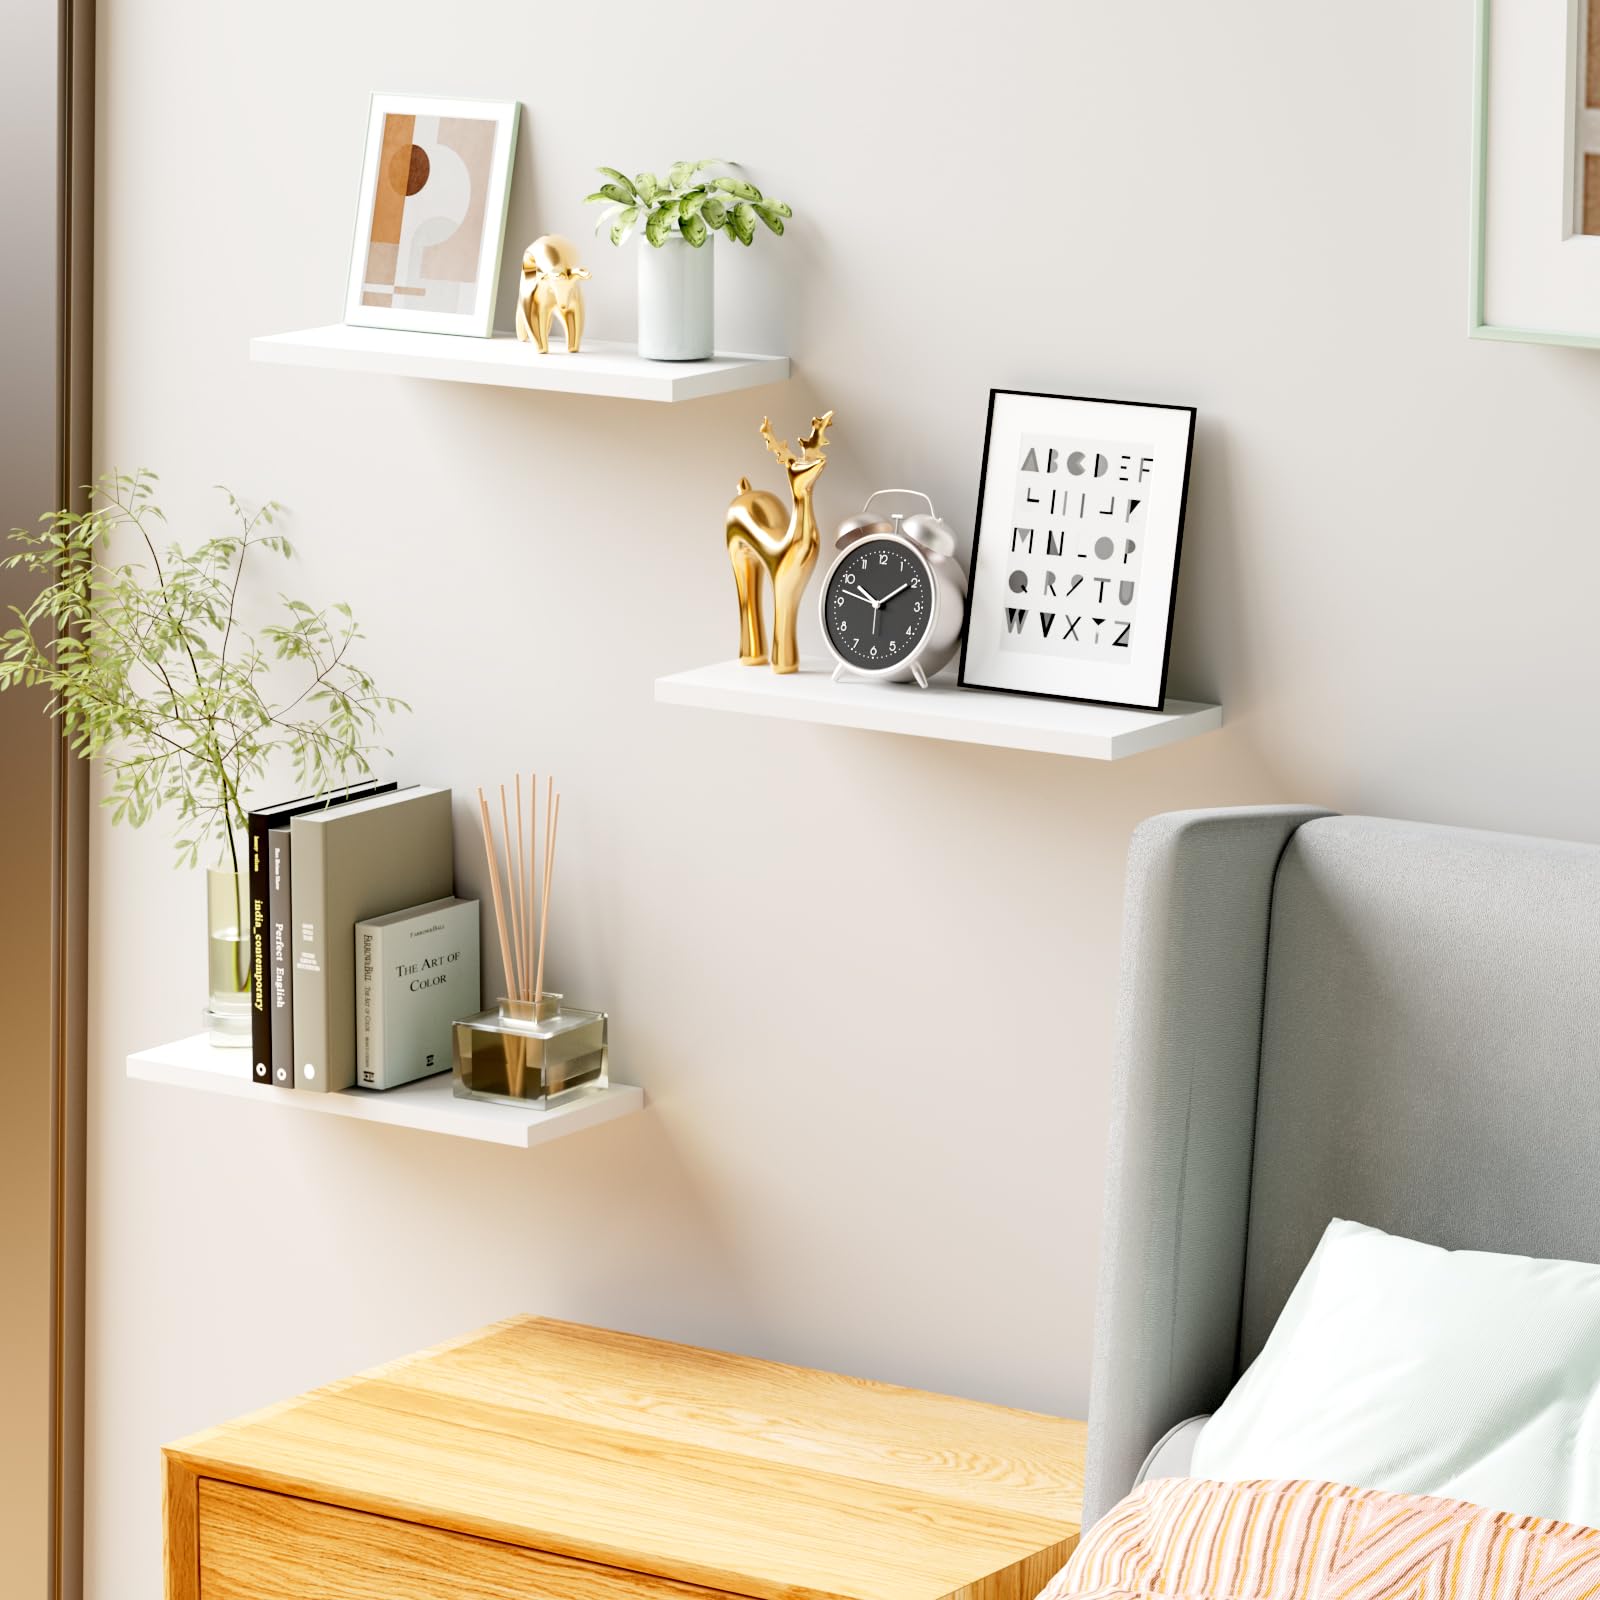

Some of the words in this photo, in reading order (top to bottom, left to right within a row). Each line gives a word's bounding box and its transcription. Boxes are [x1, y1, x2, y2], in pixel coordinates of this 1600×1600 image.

[861, 559, 867, 570] 11
[879, 554, 888, 565] 12
[844, 573, 856, 584] 10
[911, 578, 918, 589] 2
[837, 597, 844, 607] 9
[913, 602, 920, 612] 3
[840, 621, 847, 631] 8
[905, 626, 912, 636] 4
[852, 638, 859, 649] 7
[889, 641, 896, 652] 5
[870, 646, 877, 656] 6
[275, 922, 285, 962] Perfect
[253, 899, 264, 1011] india_contemporary
[395, 964, 419, 977] THE
[421, 955, 445, 971] ART
[447, 951, 461, 962] OF
[274, 967, 285, 1008] English
[409, 974, 447, 992] COLOR
